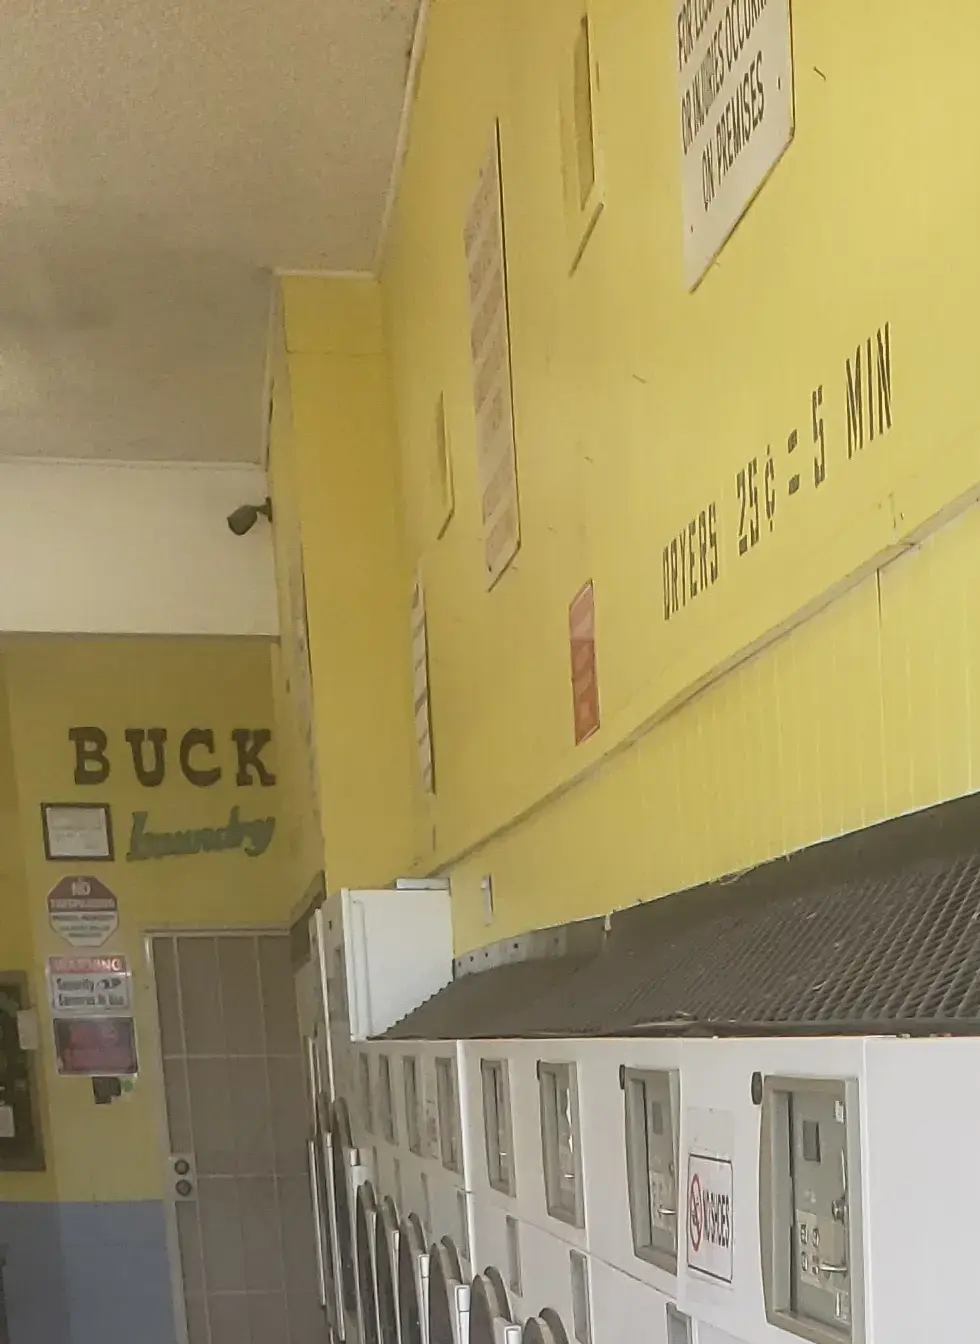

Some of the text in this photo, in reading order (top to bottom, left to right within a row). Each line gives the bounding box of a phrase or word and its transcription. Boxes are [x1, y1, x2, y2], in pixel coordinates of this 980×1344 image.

[681, 88, 693, 155] OR
[701, 50, 765, 212] ON PREMISES
[663, 501, 719, 621] DRYERS
[812, 384, 826, 489] 5
[845, 321, 892, 461] MIN
[68, 726, 276, 788] BUCK
